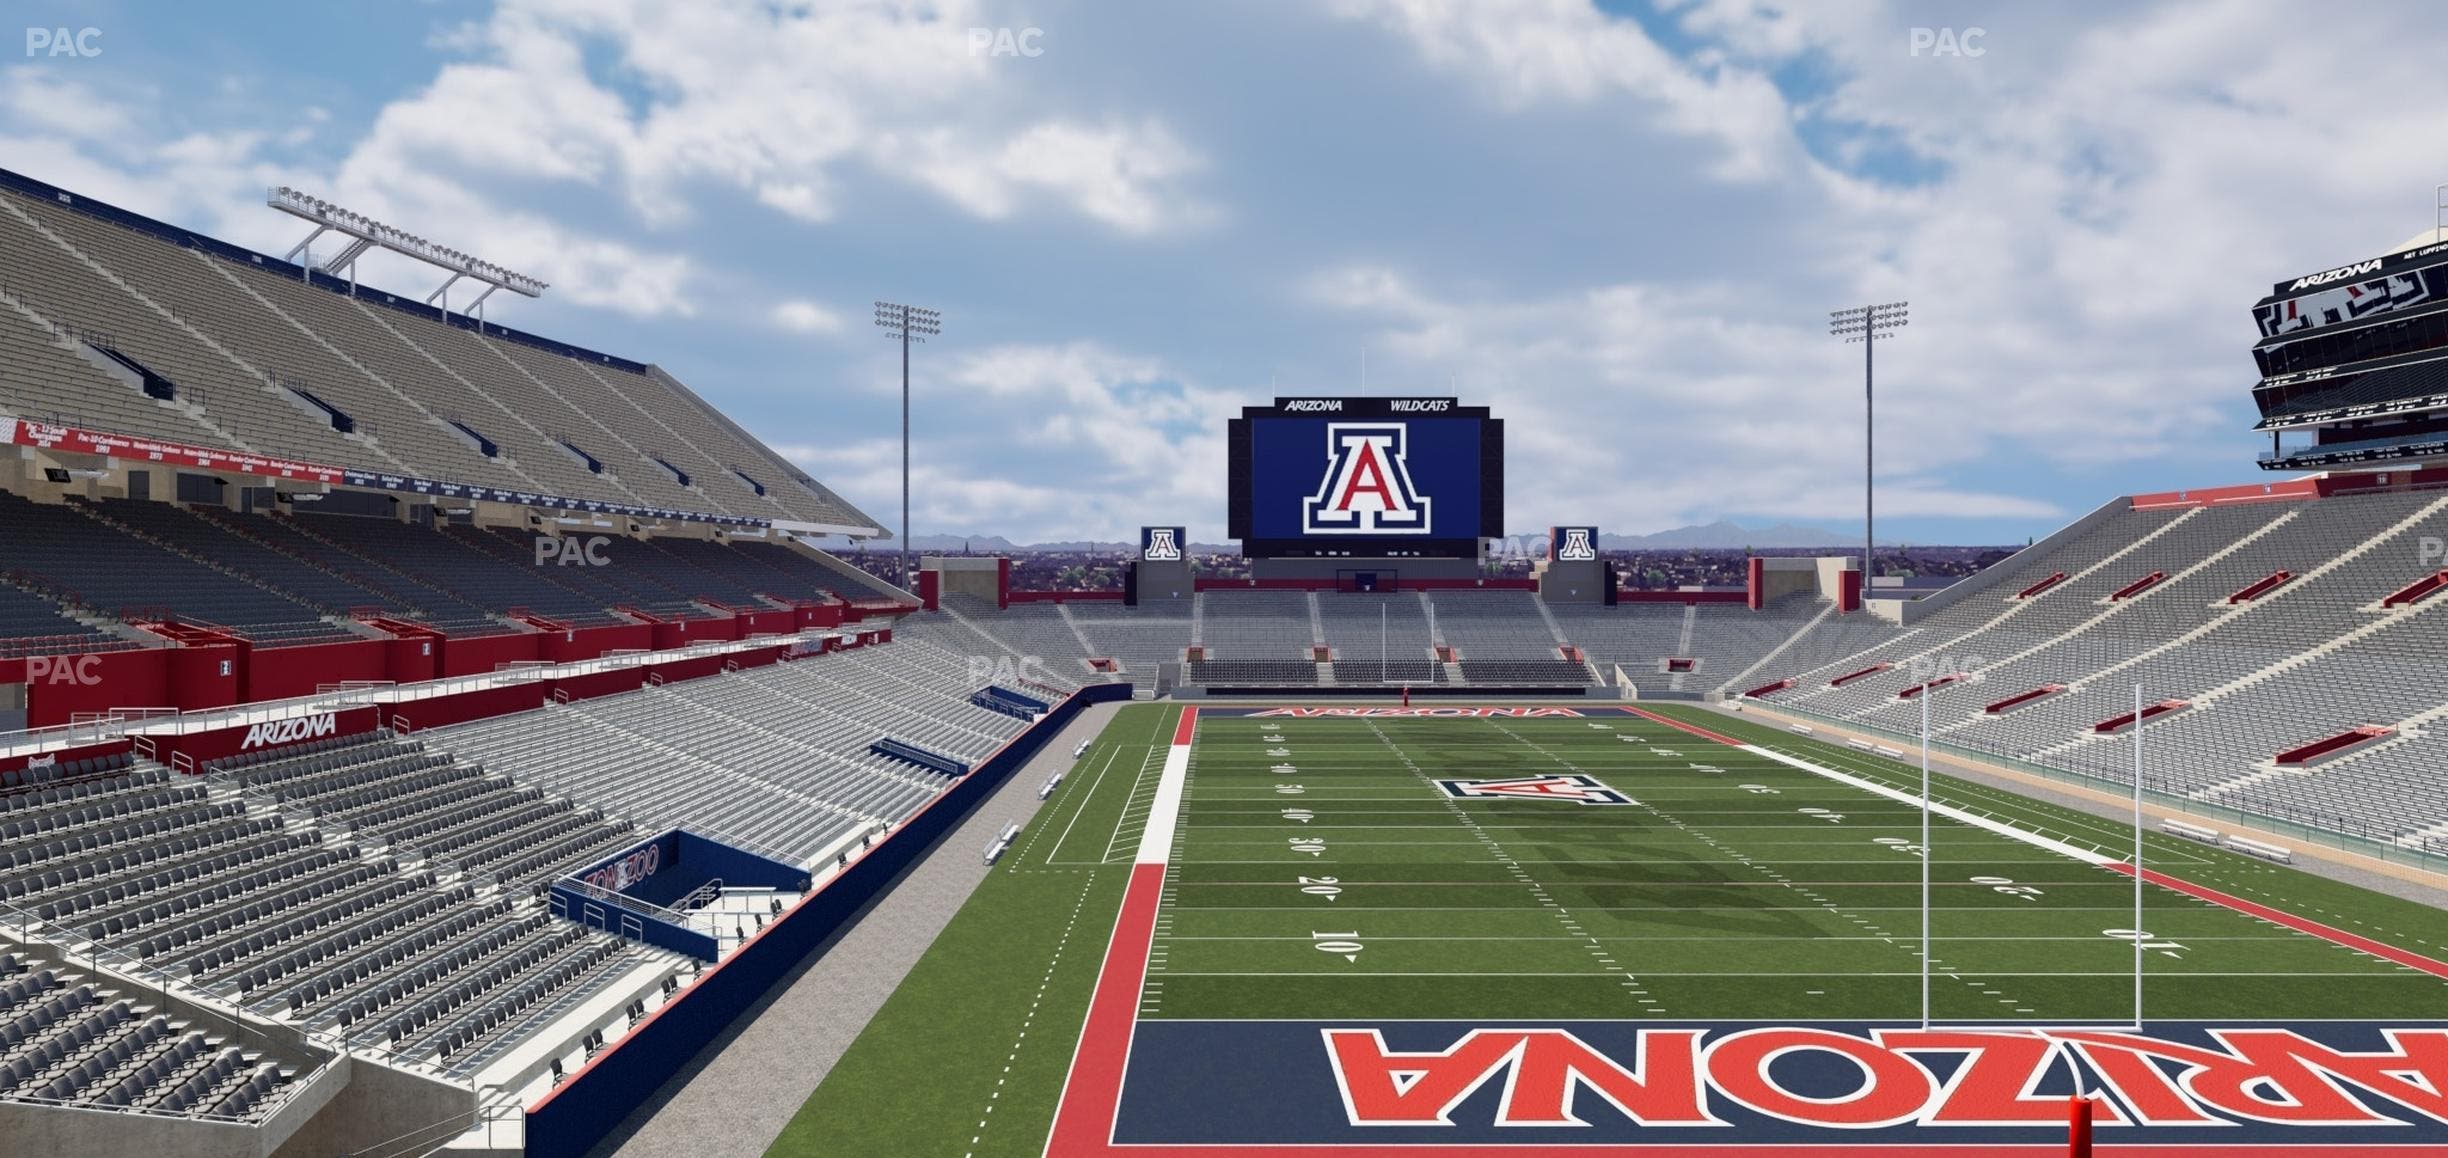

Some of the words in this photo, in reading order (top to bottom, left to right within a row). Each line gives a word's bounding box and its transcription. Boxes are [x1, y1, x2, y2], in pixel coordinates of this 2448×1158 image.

[2289, 259, 2382, 292] ARIZONA
[1284, 400, 1343, 411] ARIZONA
[1390, 400, 1449, 411] WILDCATS
[1245, 707, 1585, 717] ARIZONA
[241, 713, 336, 750] ARIZONA
